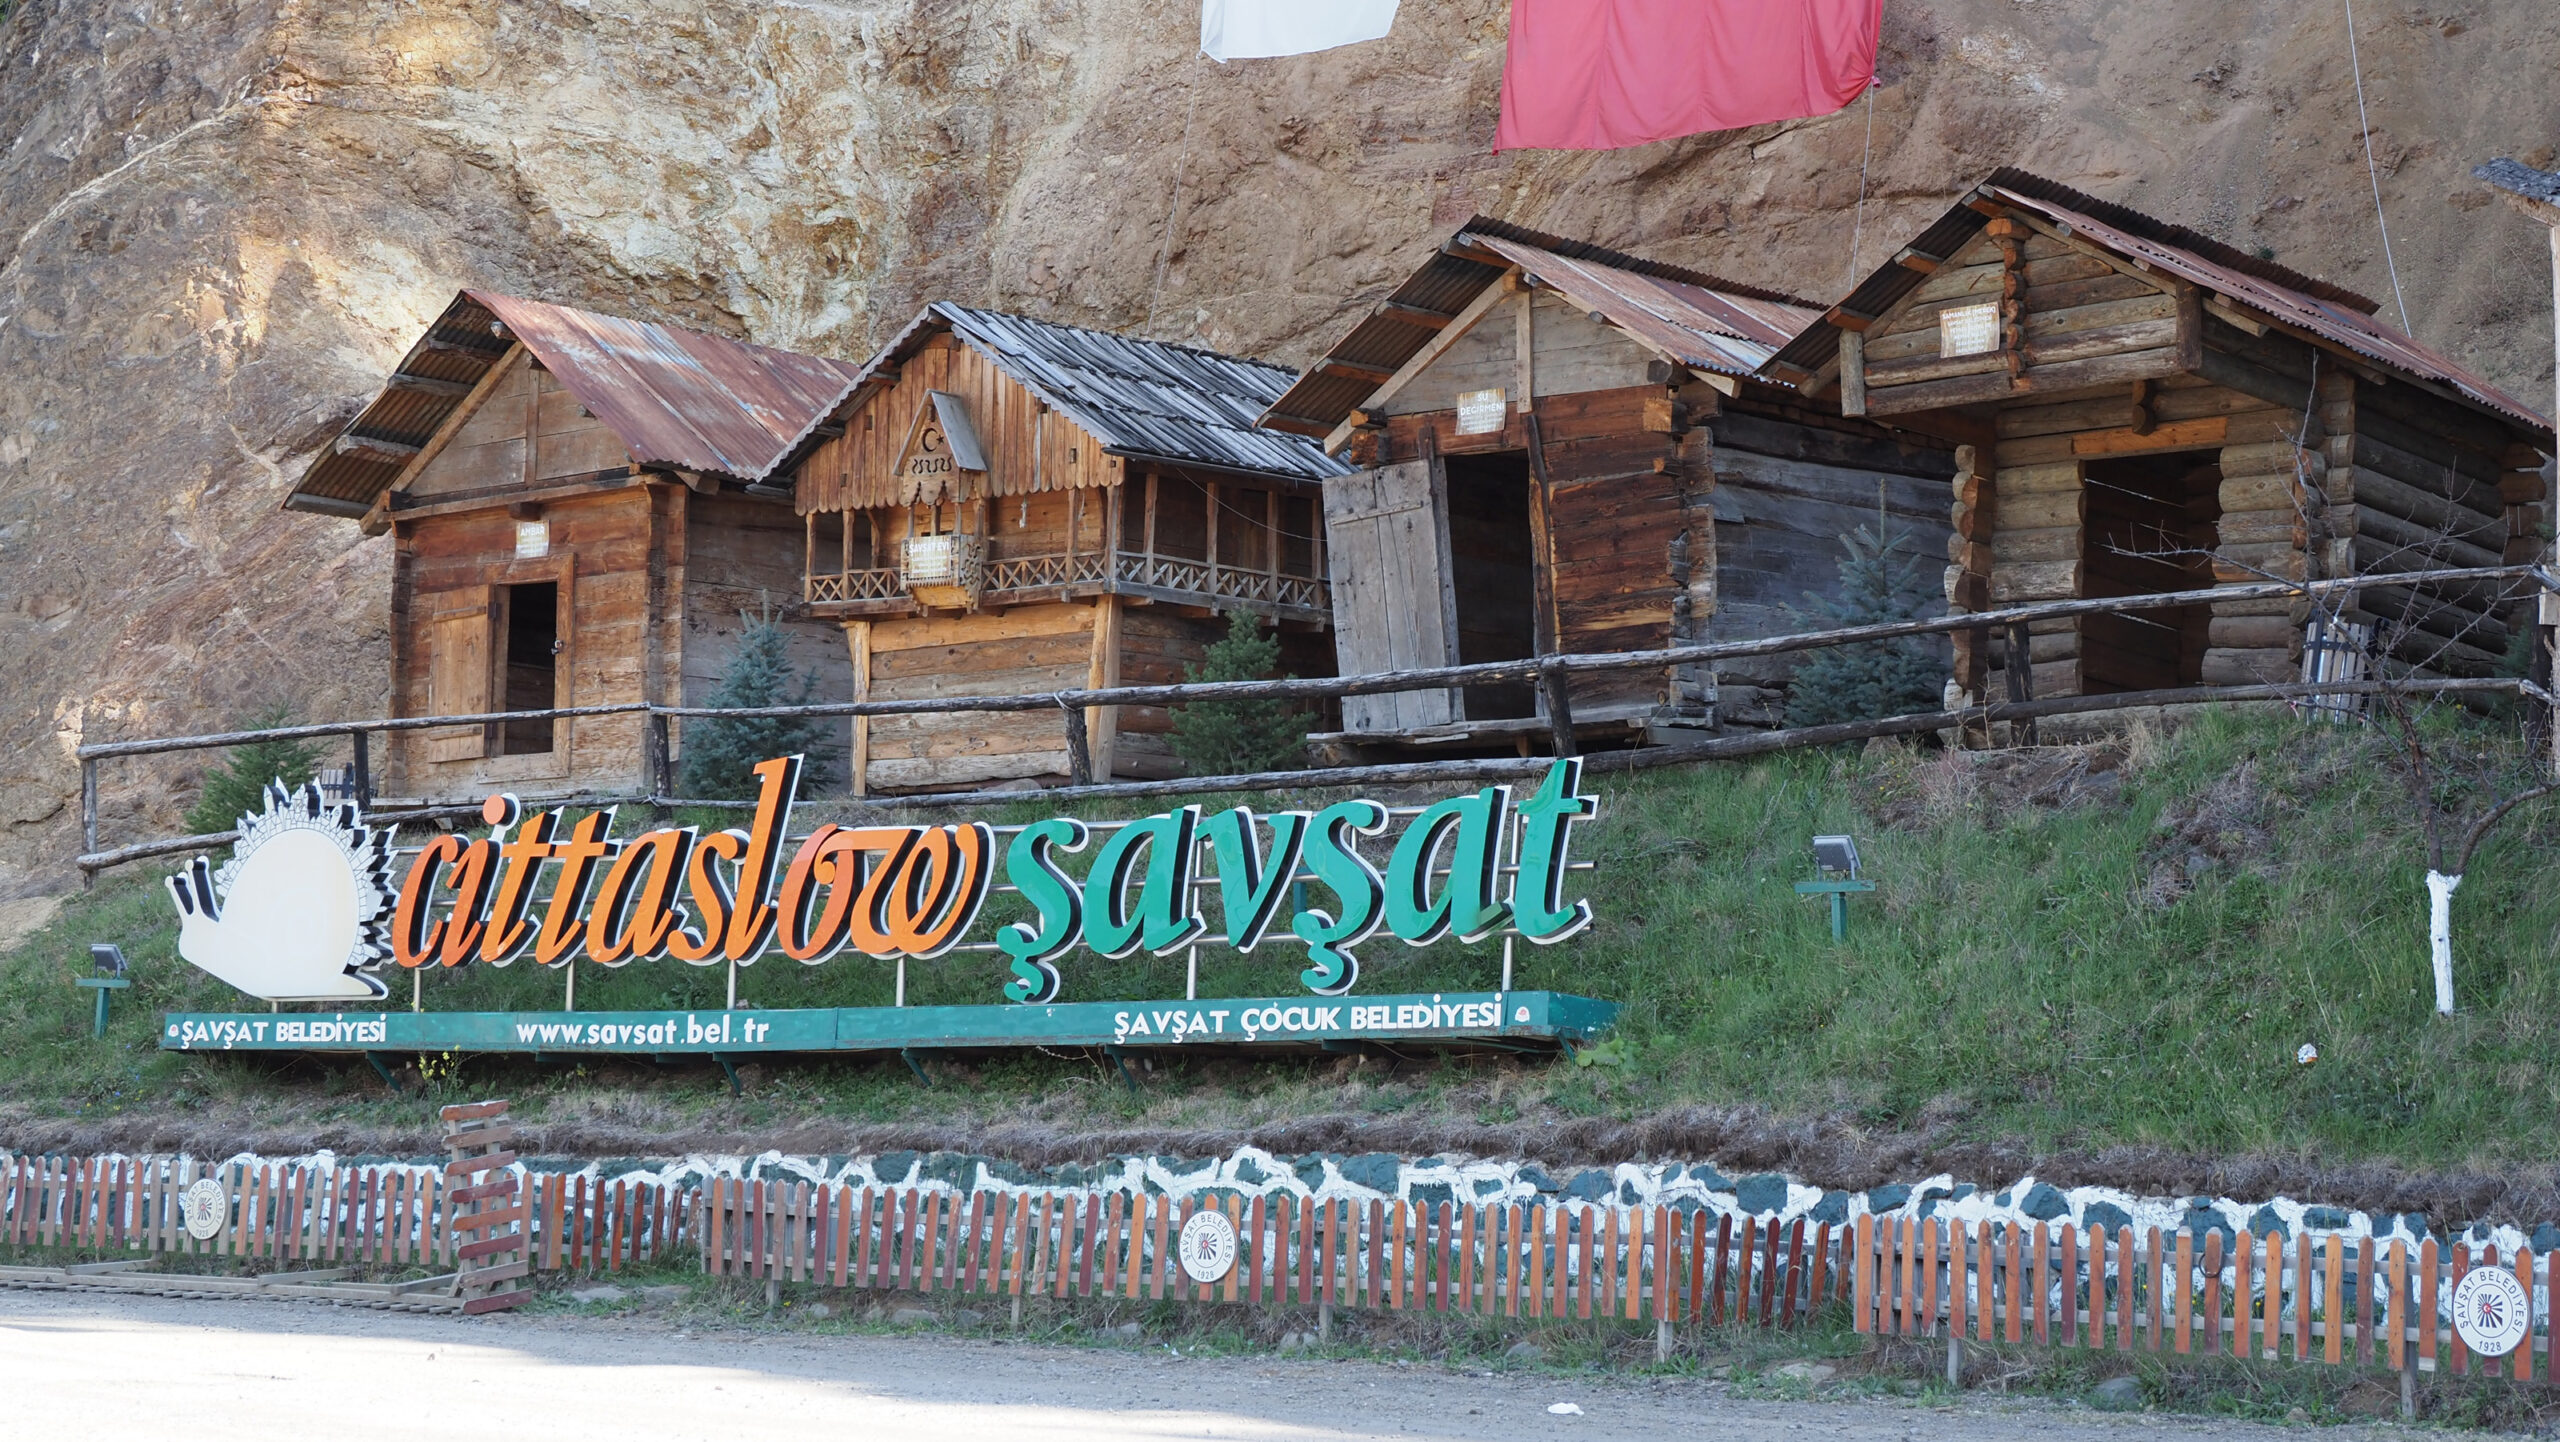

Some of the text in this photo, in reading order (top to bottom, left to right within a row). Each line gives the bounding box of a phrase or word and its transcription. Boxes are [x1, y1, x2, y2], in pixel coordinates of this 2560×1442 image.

[1478, 391, 1488, 401] SU
[392, 753, 1598, 1003] cittaslow şavşat
[180, 1012, 388, 1050] ŞAVŞAT BELEDİYESİ
[1114, 992, 1503, 1045] ŞAVŞAT ÇOCUK BELEDİYESİ
[1196, 1270, 1215, 1280] 1928
[2478, 1340, 2502, 1353] 1928
